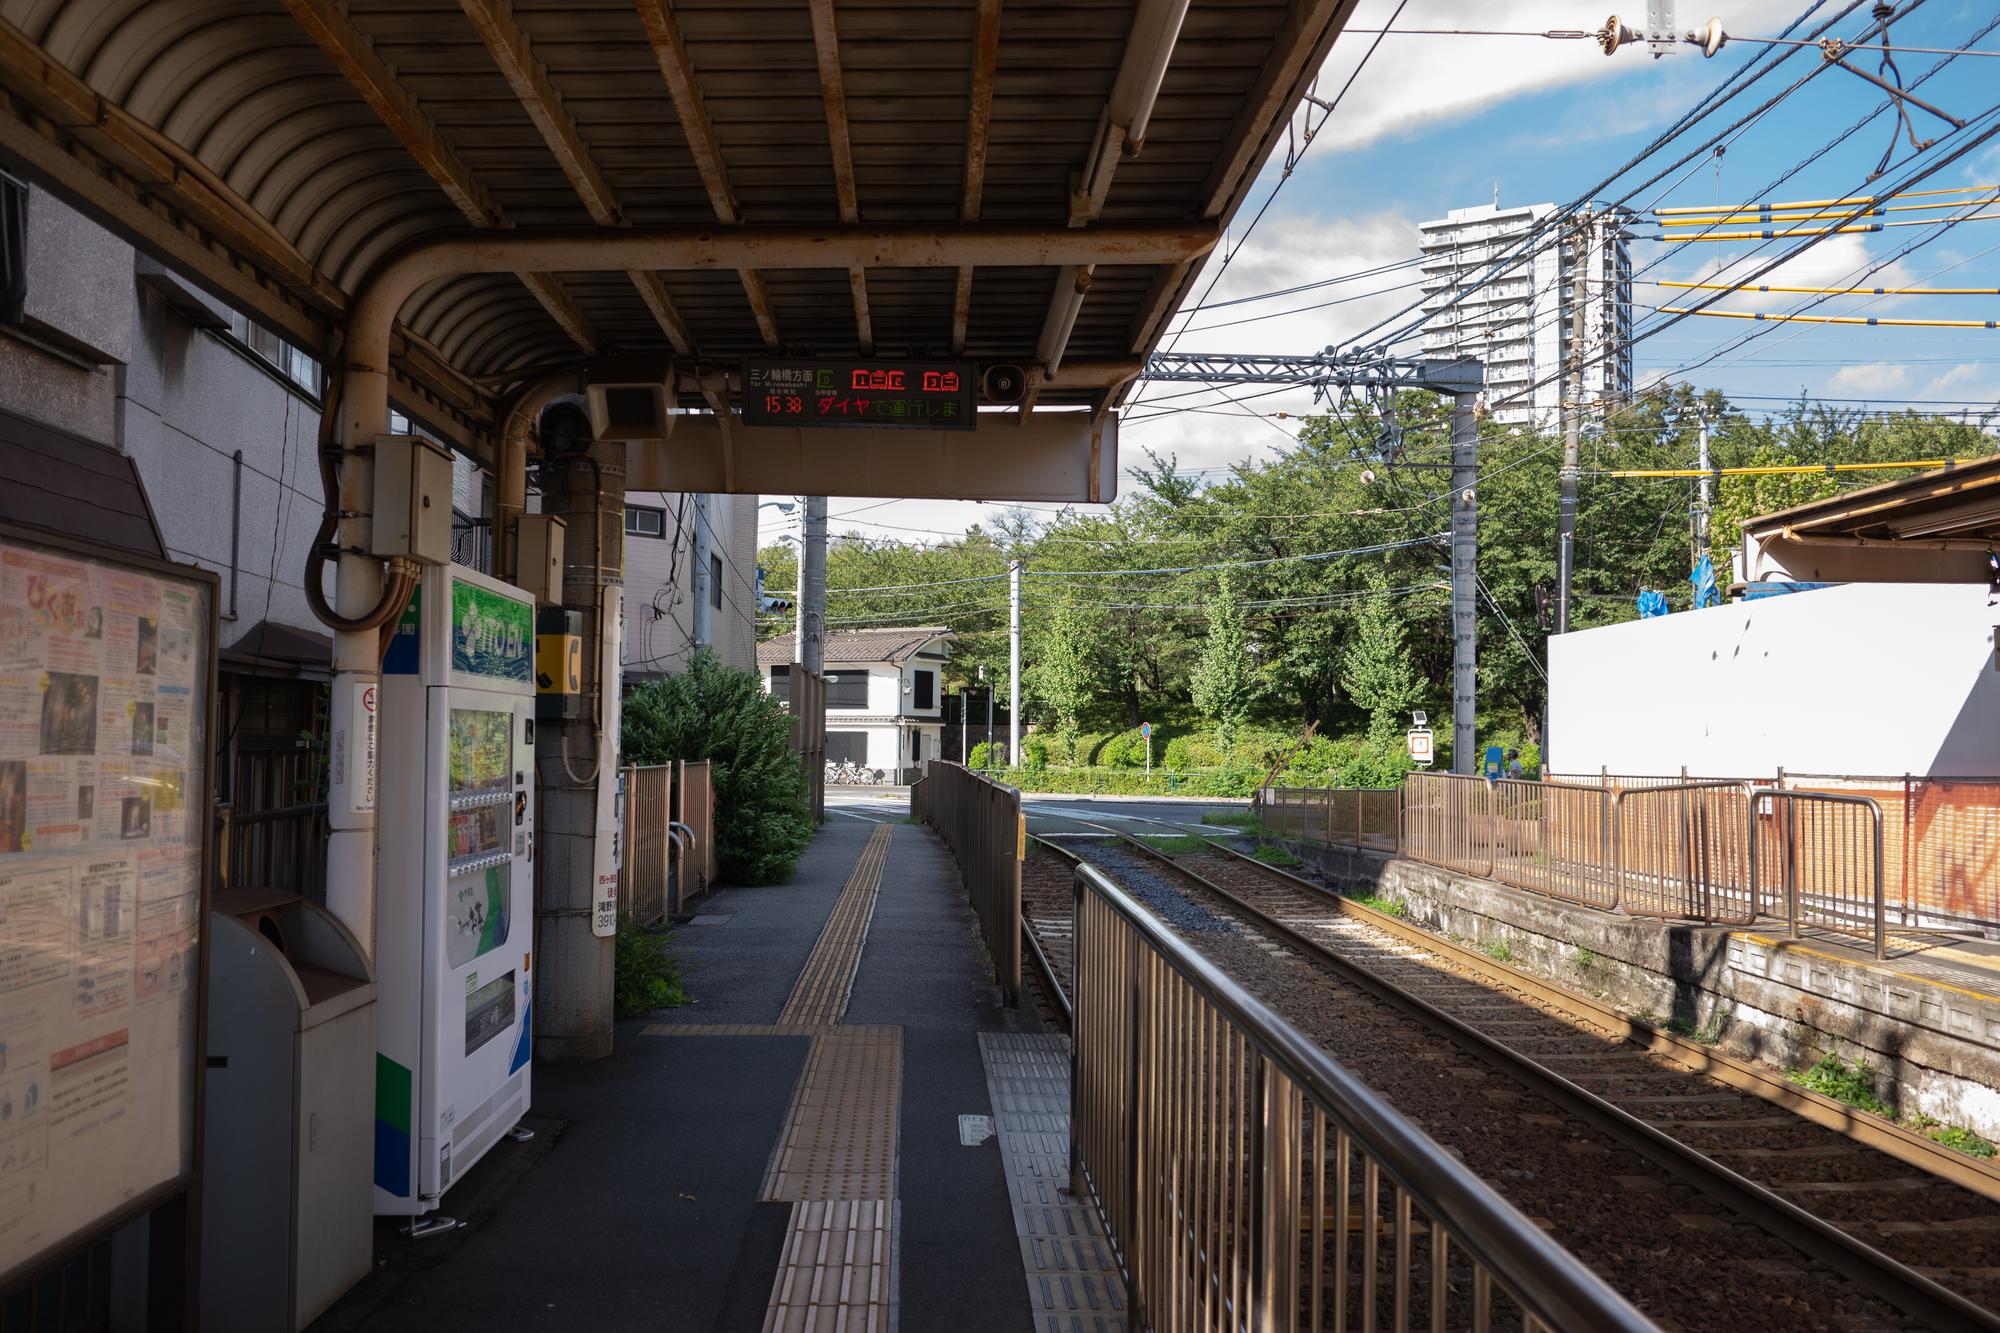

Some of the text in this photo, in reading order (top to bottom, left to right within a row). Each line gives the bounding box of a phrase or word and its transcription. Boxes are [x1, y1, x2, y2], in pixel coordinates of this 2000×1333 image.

[750, 368, 813, 383] 三ノ輪橋方面
[766, 396, 802, 414] 15 38
